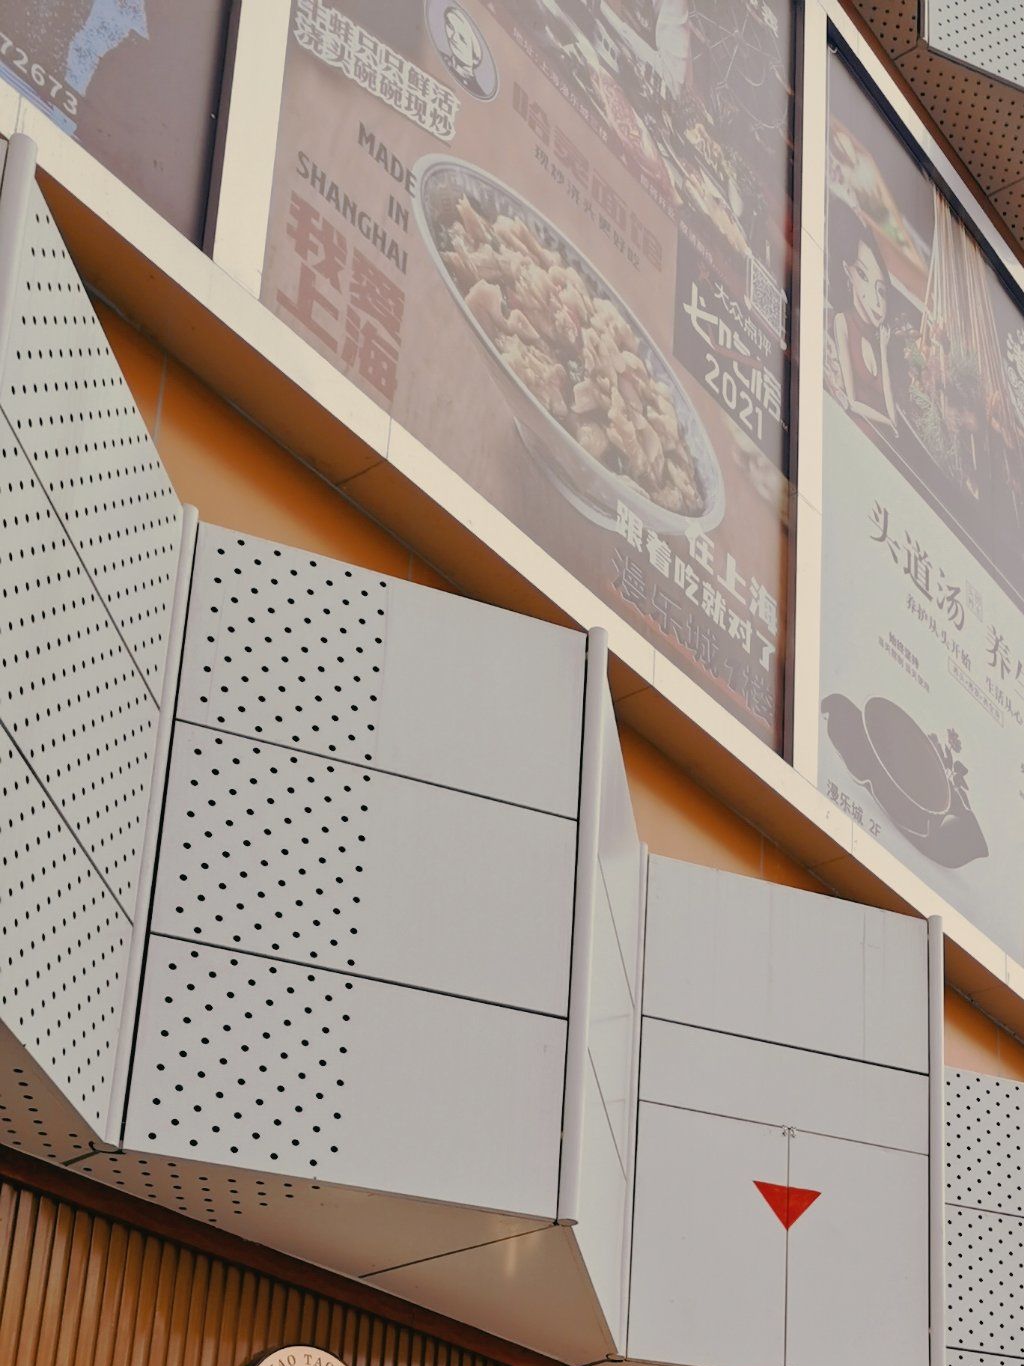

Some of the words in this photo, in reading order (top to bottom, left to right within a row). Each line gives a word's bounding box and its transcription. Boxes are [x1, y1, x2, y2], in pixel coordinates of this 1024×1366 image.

[358, 120, 417, 198] MADE
[297, 150, 408, 275] SHANGHAI
[387, 194, 410, 233] IN
[714, 282, 773, 357] 大众点评
[705, 353, 763, 440] 2021
[616, 500, 775, 672] 跟着吃就对了
[685, 531, 778, 636] 在上海
[870, 499, 966, 632] 头道汤
